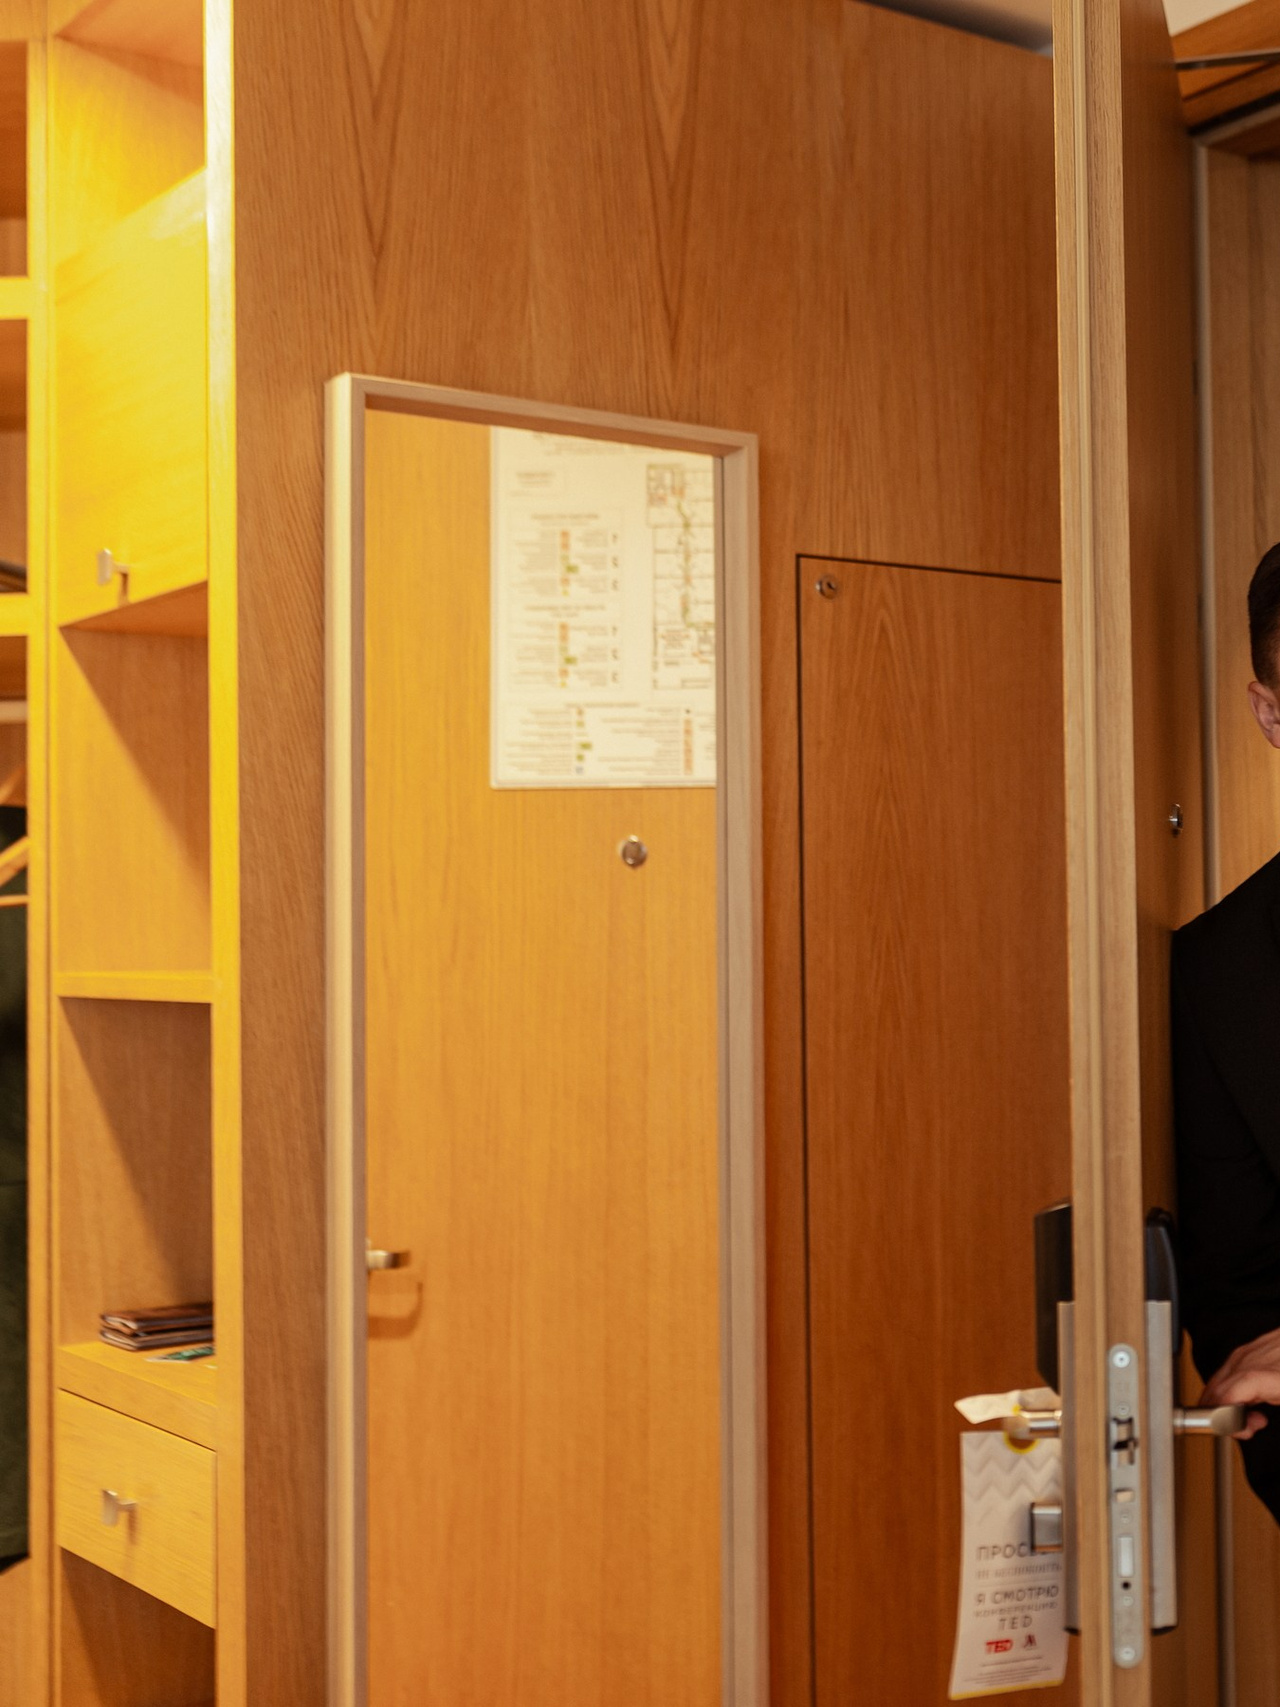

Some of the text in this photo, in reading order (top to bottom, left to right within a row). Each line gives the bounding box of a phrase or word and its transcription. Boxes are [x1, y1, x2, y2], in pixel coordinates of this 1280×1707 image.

[976, 1585, 1059, 1607] Я СМОТРЮ
[999, 1615, 1033, 1631] TED
[985, 1638, 1014, 1655] TED
